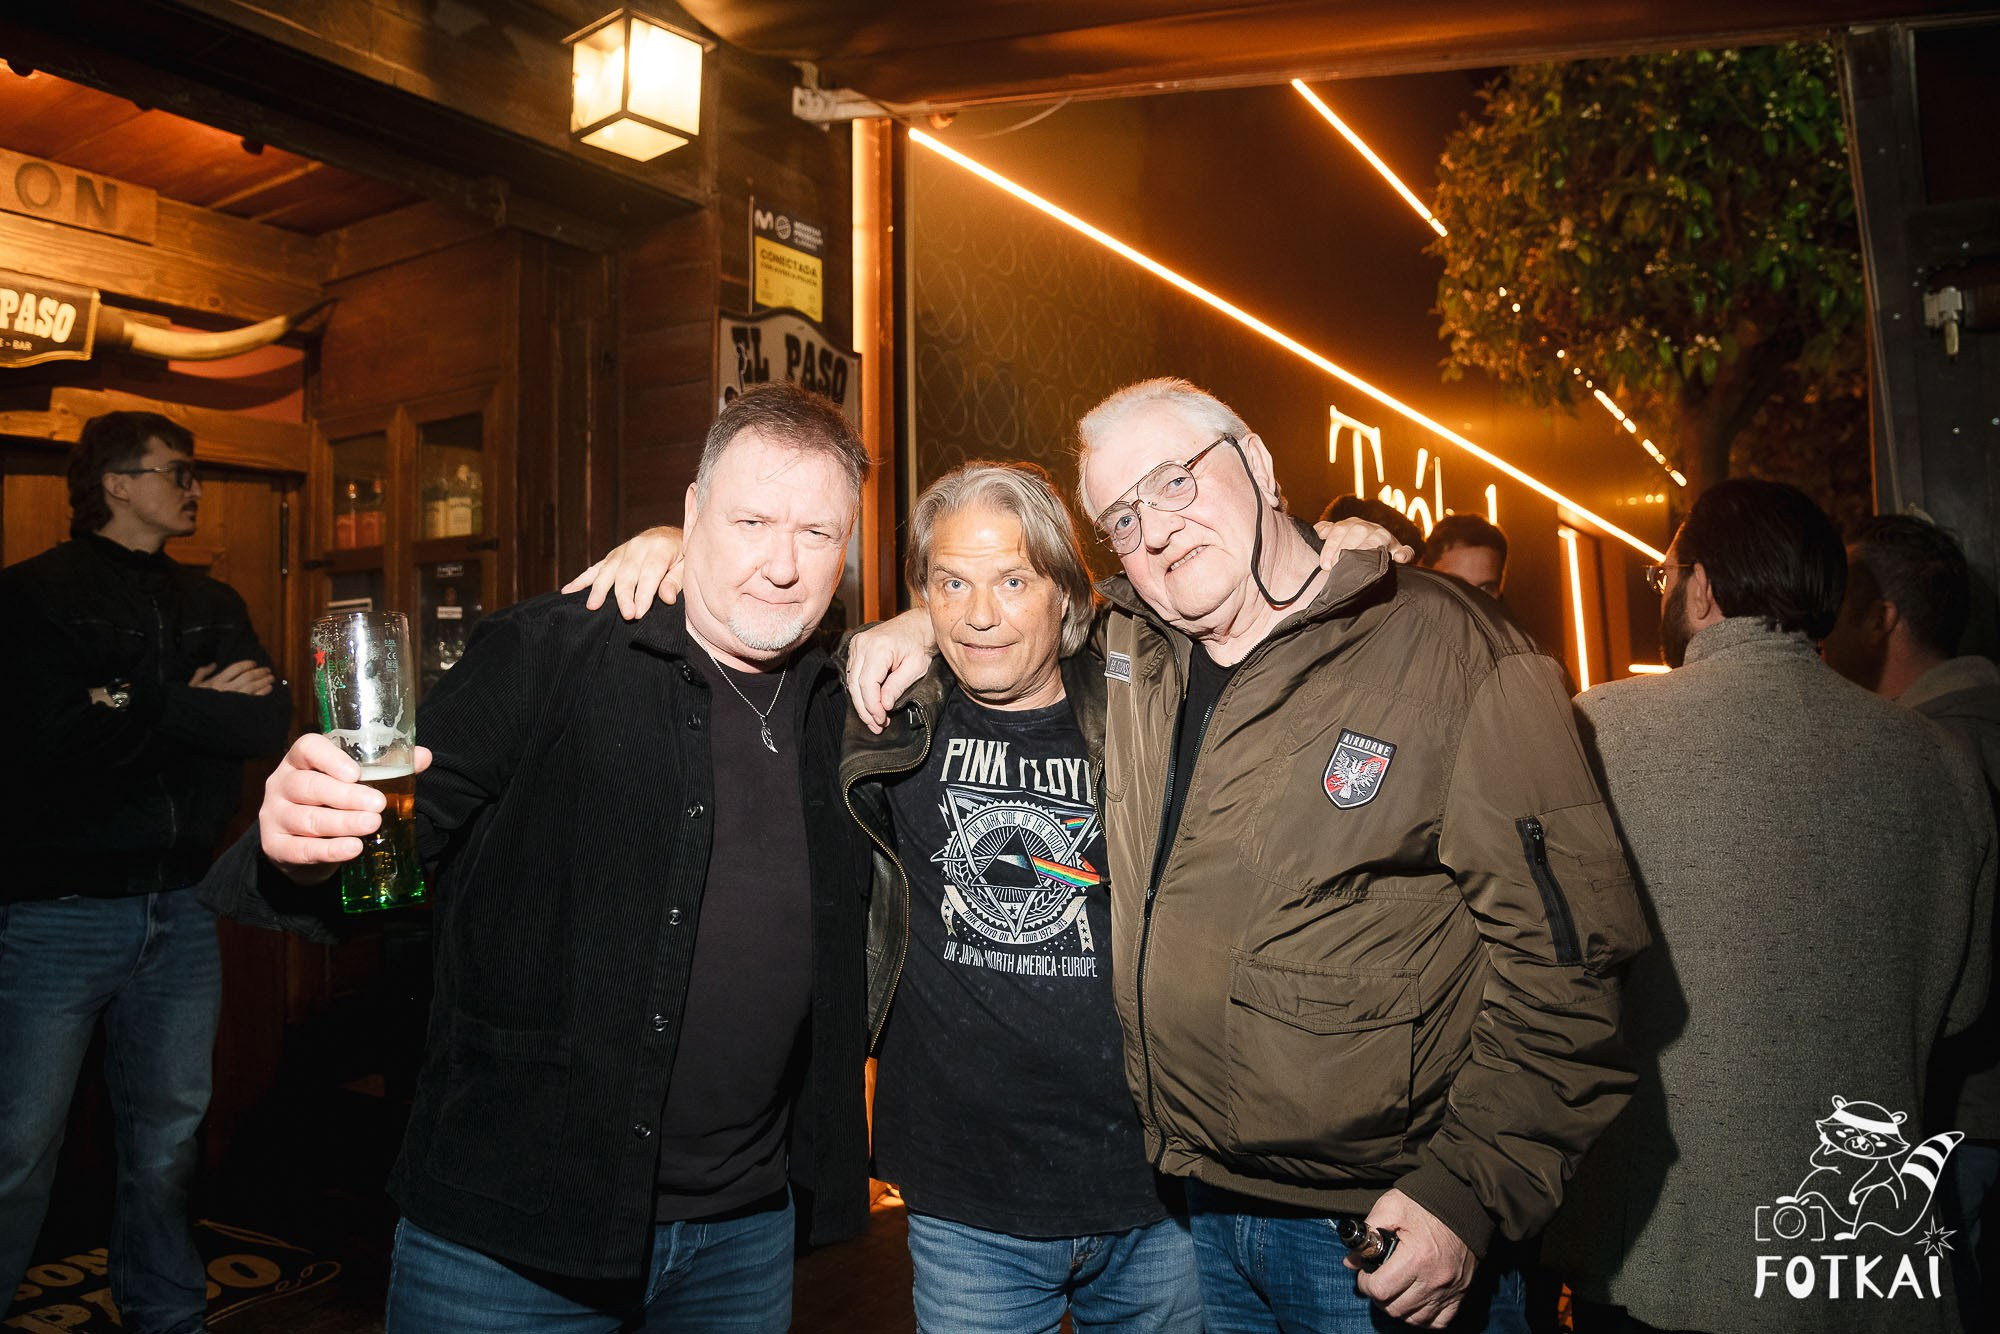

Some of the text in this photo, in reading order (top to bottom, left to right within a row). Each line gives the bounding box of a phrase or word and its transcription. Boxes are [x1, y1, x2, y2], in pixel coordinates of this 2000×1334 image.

[0, 287, 77, 343] PASO
[785, 332, 848, 405] PASO
[939, 738, 1011, 787] PINK
[1342, 733, 1391, 757] AIRBORNE
[967, 811, 1066, 855] THE DARK SIDE OF THE MOON
[962, 909, 979, 926] PINK
[977, 921, 997, 939] FLOYD
[998, 931, 1010, 942] ON
[1022, 932, 1038, 943] TOUR
[1038, 926, 1054, 940] 1972
[943, 940, 957, 962] UK
[1015, 954, 1058, 977] AMERICA
[1062, 956, 1098, 978] EUROPE
